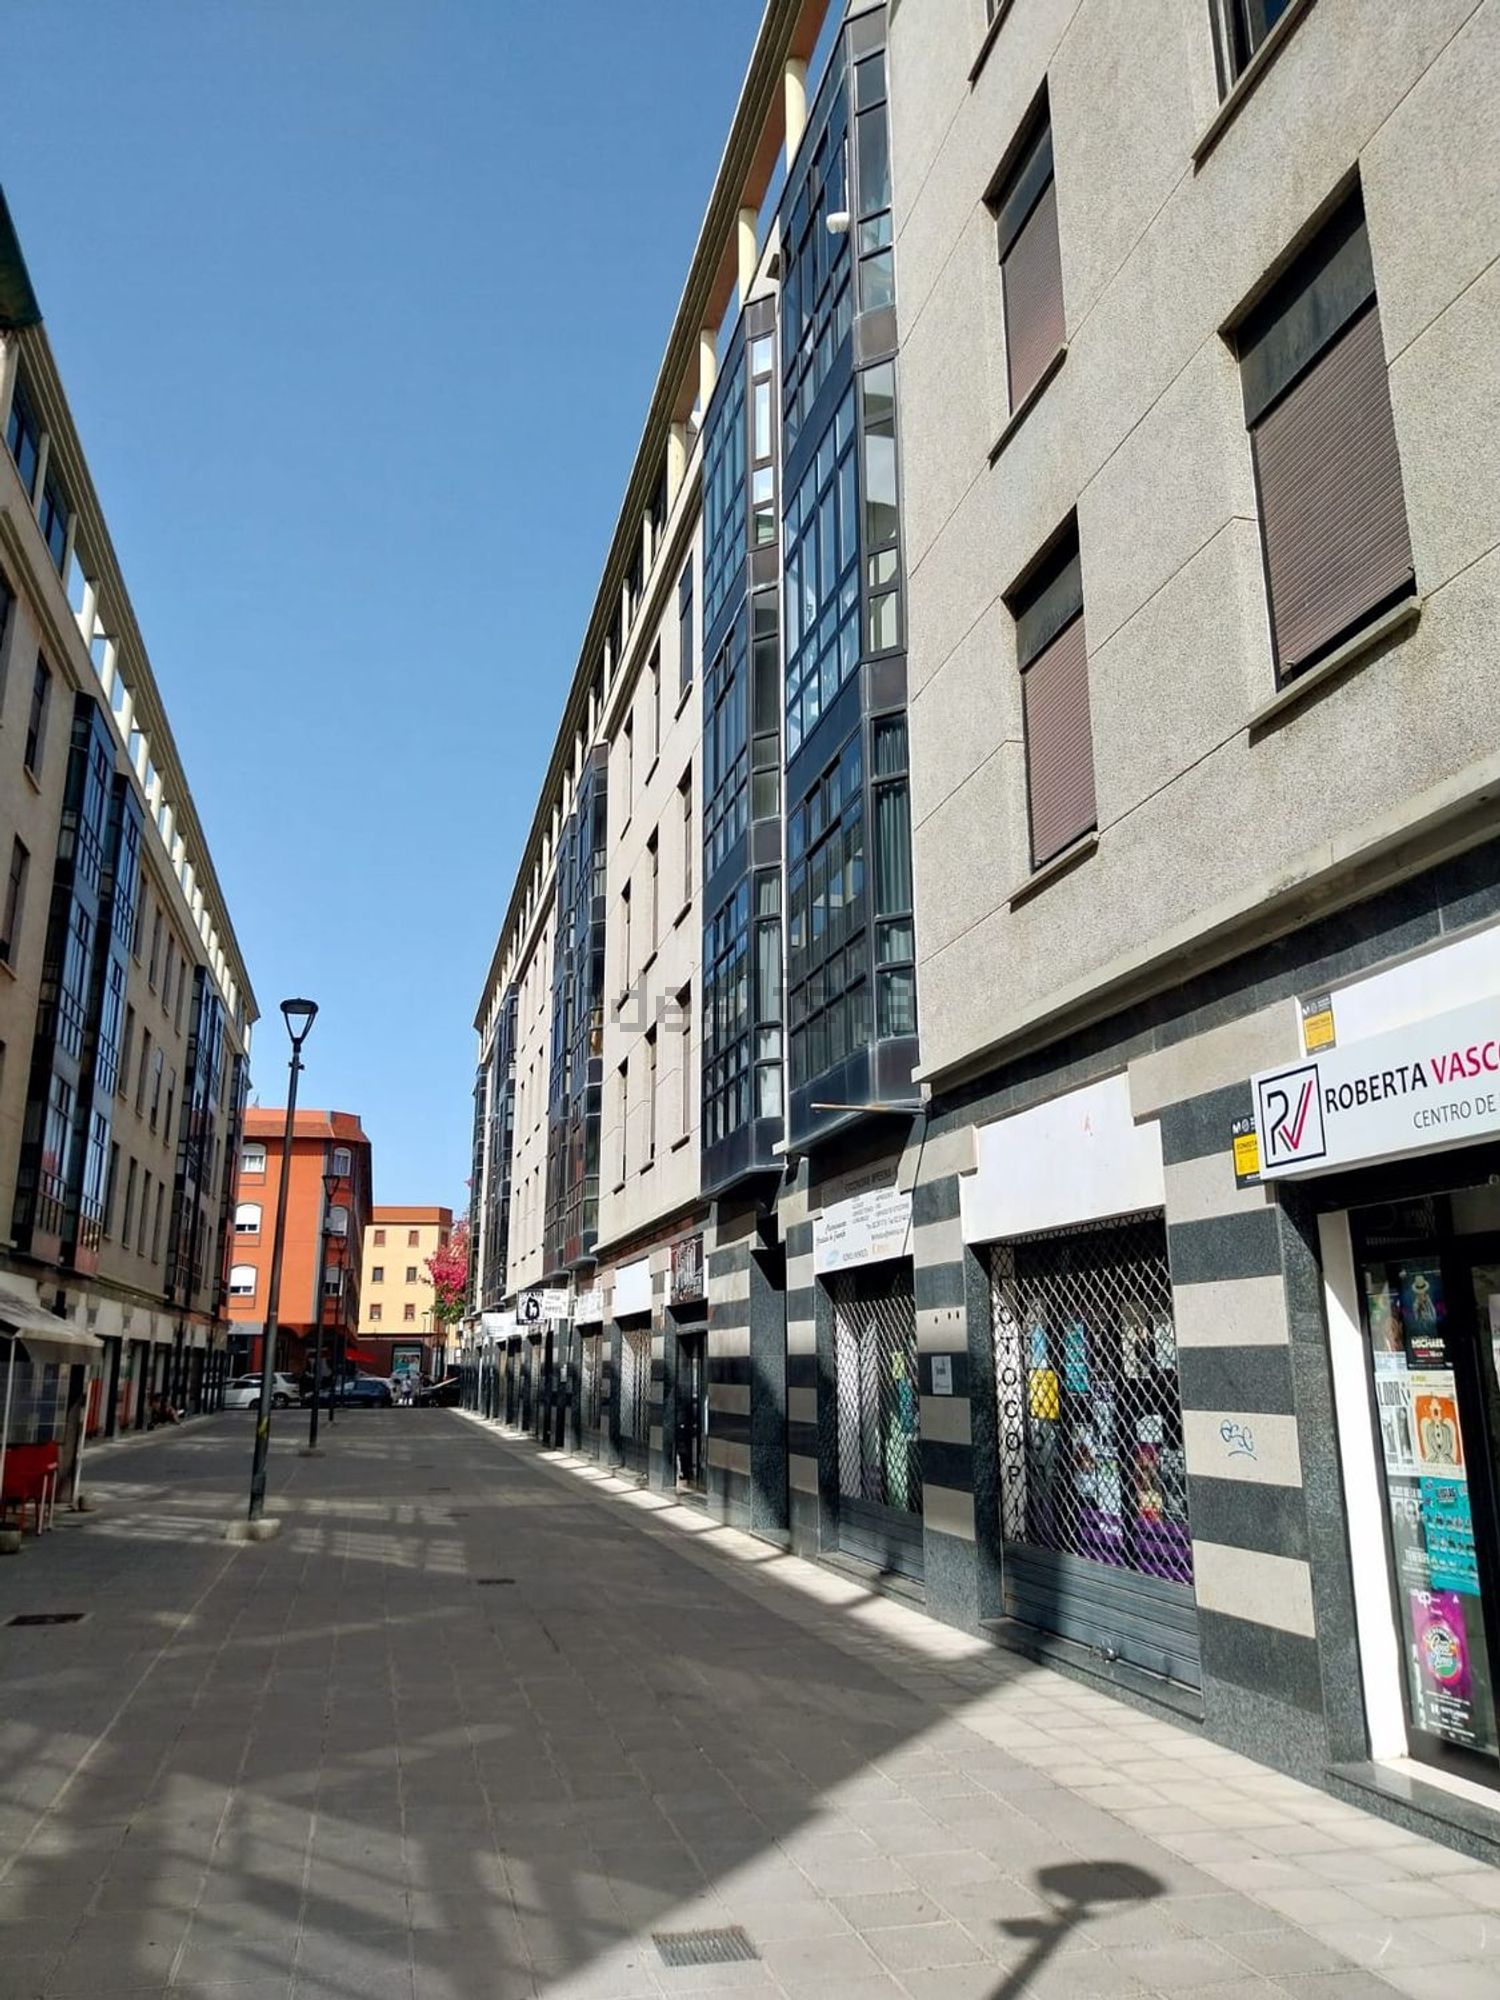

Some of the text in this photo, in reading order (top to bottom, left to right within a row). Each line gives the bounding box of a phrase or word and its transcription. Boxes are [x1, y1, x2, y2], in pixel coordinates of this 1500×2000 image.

[1325, 1041, 1500, 1113] ROBERTA VASC
[1413, 1094, 1496, 1129] CENTRO DE
